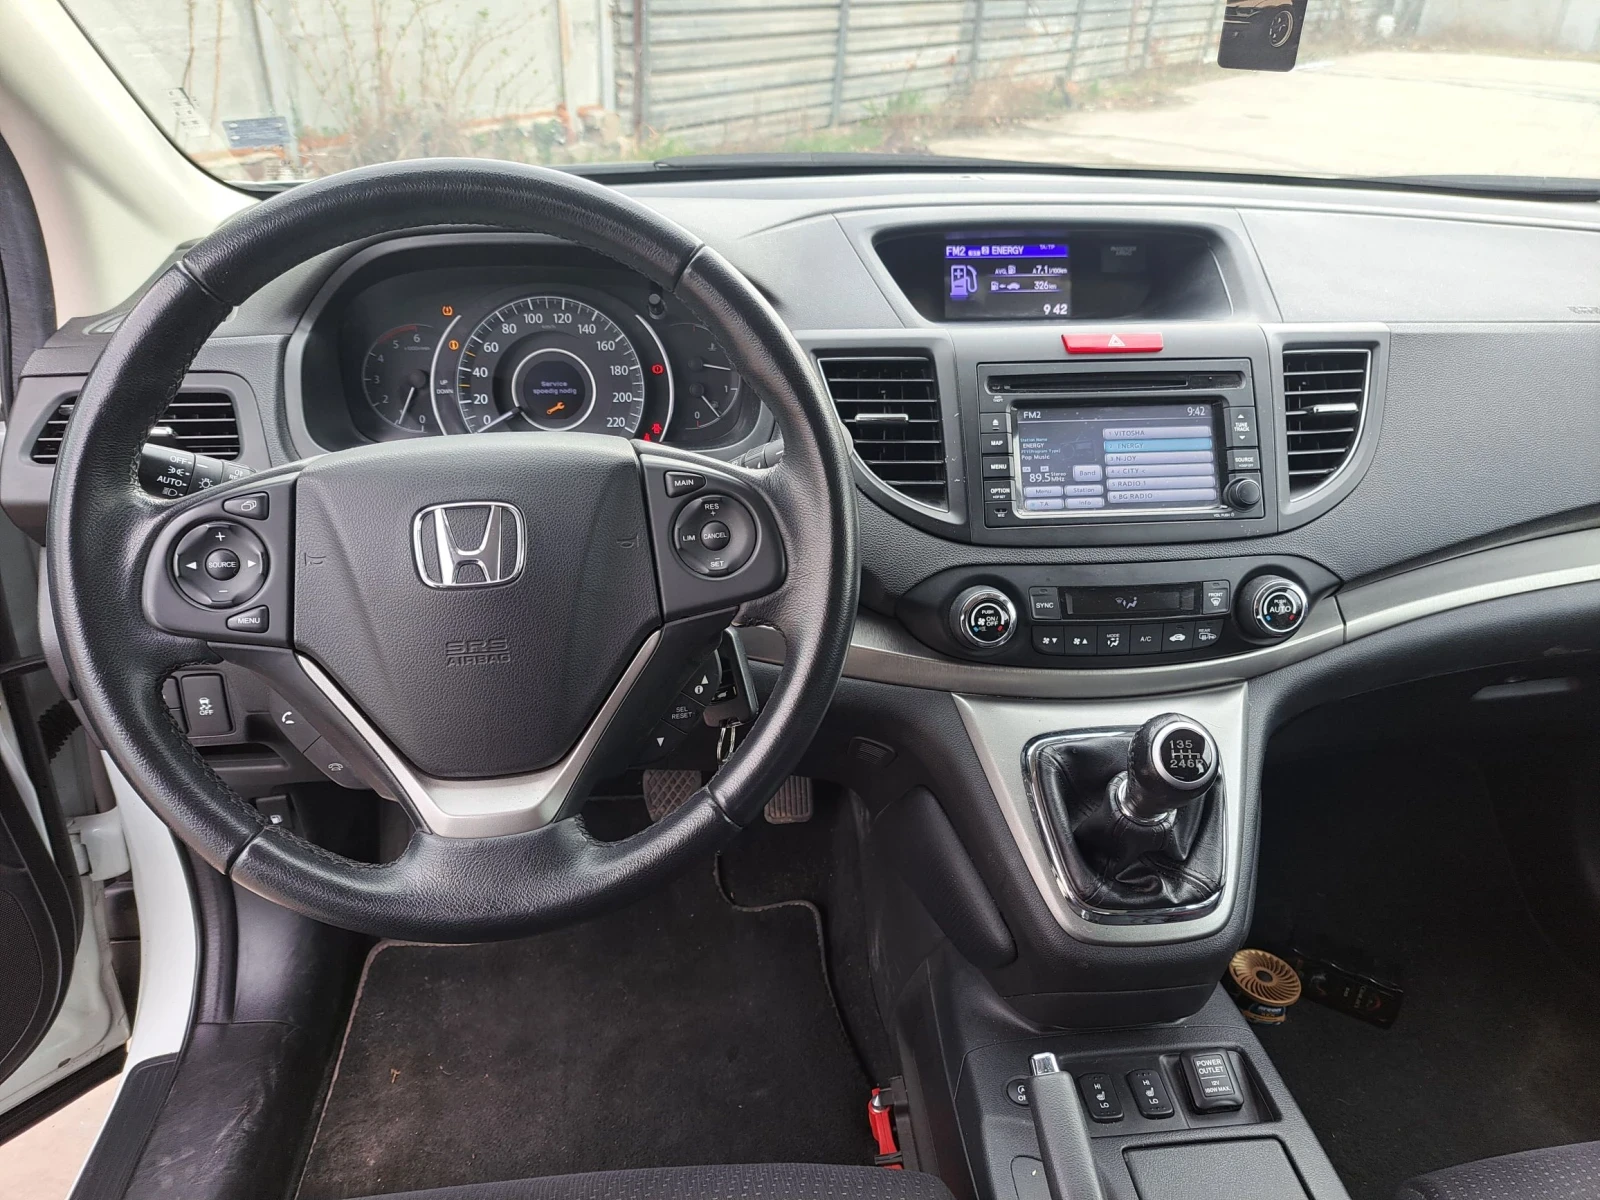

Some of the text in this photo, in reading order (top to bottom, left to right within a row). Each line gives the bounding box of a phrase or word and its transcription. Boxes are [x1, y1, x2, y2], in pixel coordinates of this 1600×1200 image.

[946, 246, 966, 256] FM2
[992, 246, 1024, 255] ENERGY
[1034, 281, 1048, 290] 326
[523, 313, 543, 324] 100
[553, 313, 572, 324] 120
[501, 323, 517, 334] 80
[578, 323, 597, 334] 140
[413, 334, 421, 342] 6
[392, 340, 399, 349] 5
[483, 342, 499, 353] 60
[596, 341, 615, 352] 160
[377, 354, 384, 363] 4
[472, 367, 488, 378] 40
[610, 365, 628, 376] 180
[374, 375, 380, 384] 3
[382, 395, 388, 403] 2
[473, 394, 488, 405] 20
[612, 392, 632, 403] 200
[694, 411, 701, 419] 0
[1023, 411, 1041, 419] FM2
[1187, 406, 1206, 416] 9:42
[419, 415, 426, 424] 0
[484, 414, 491, 425] 0
[606, 416, 626, 427] 220
[169, 455, 186, 464] OFF
[156, 475, 182, 487] AUTO
[1029, 473, 1051, 482] 89.5
[674, 479, 694, 487] MAIN
[703, 532, 727, 540] CANCEL
[446, 640, 507, 653] SRS
[447, 655, 510, 667] AIRBAG
[1196, 1058, 1221, 1067] POWER
[1198, 1066, 1223, 1074] OUTLET
